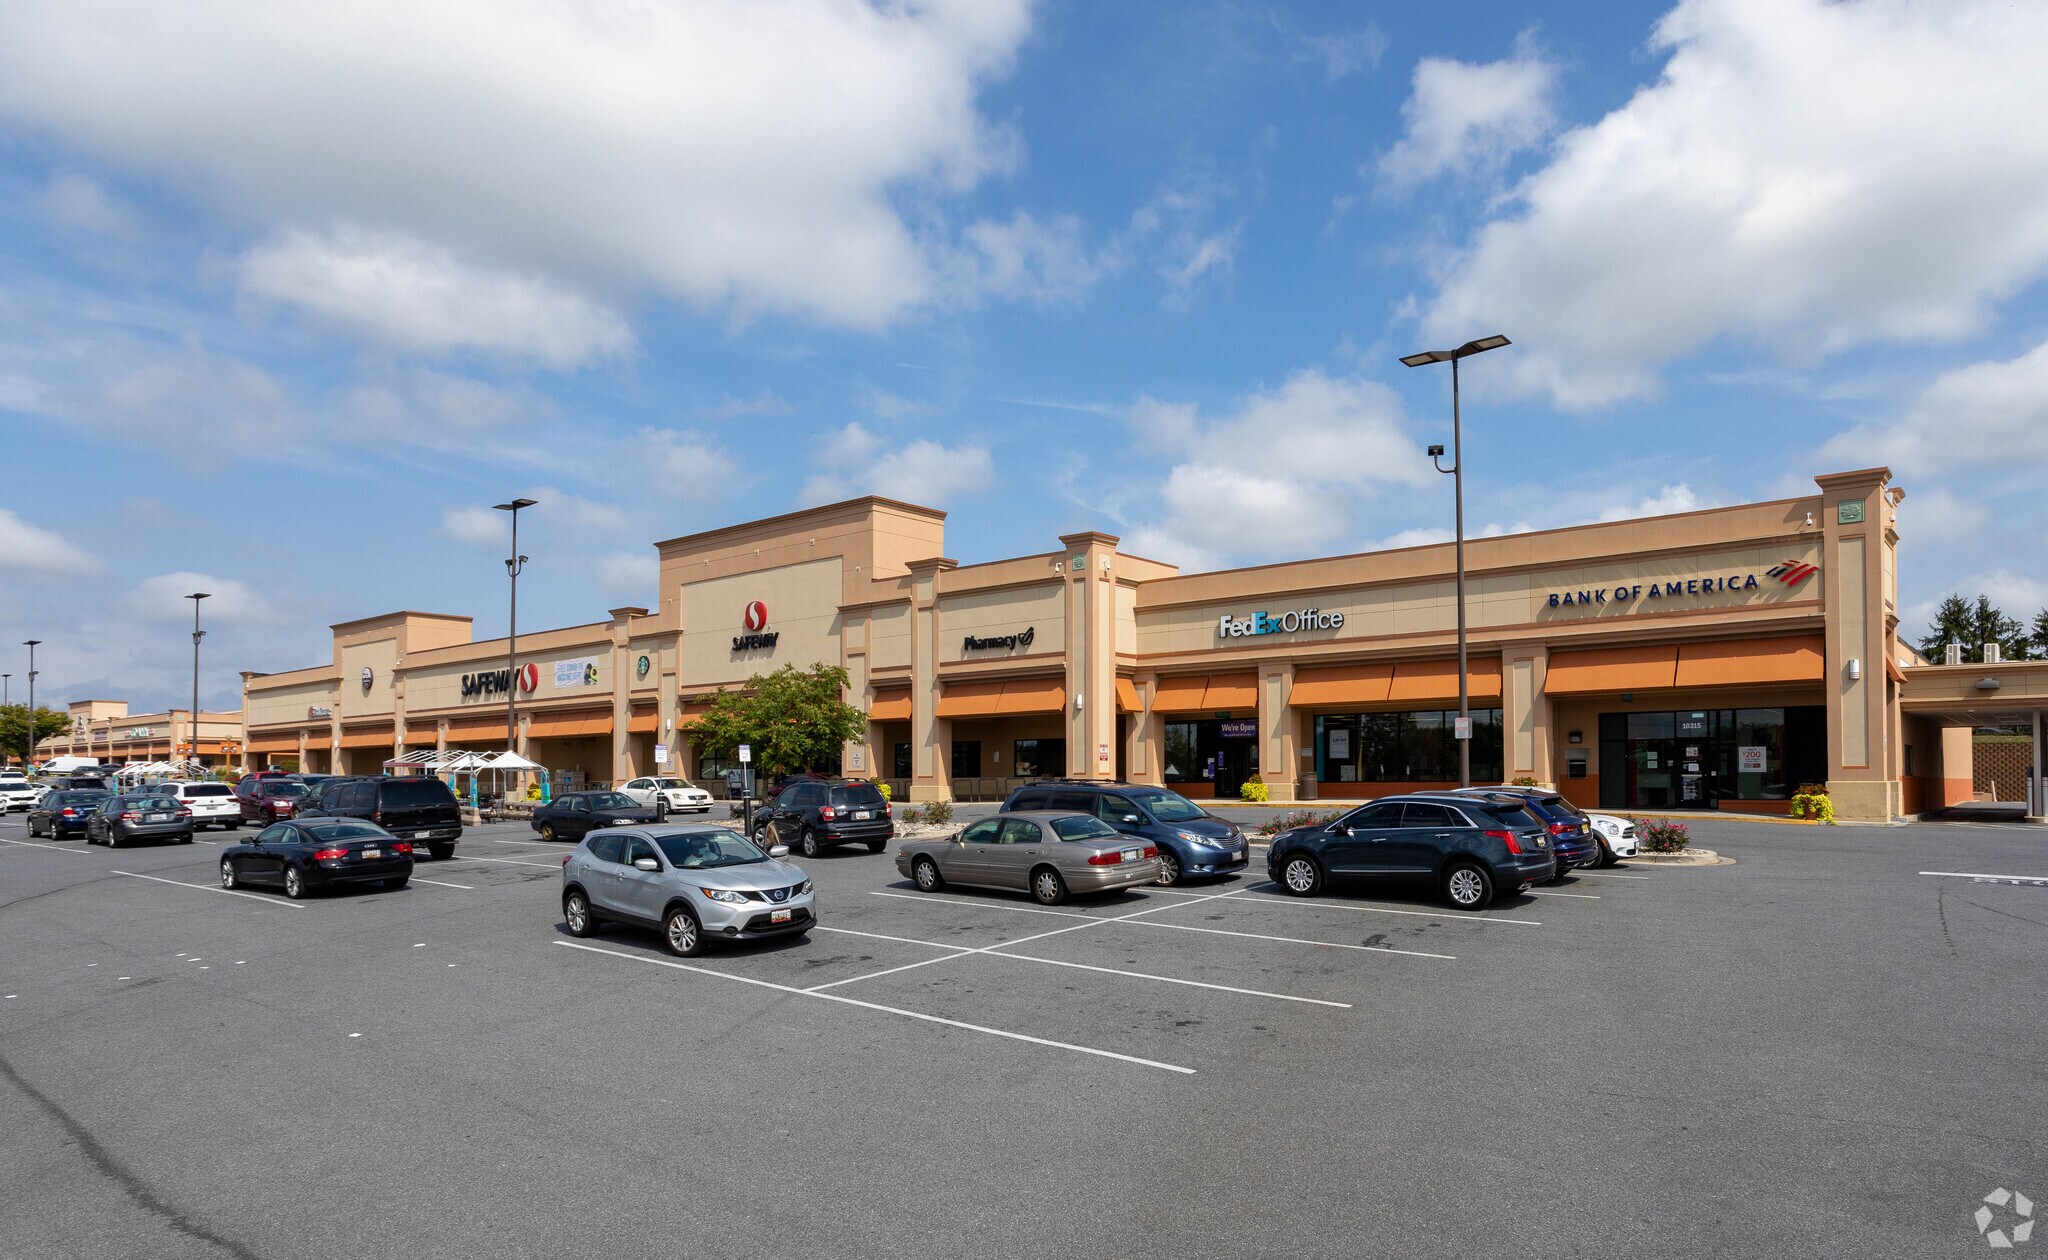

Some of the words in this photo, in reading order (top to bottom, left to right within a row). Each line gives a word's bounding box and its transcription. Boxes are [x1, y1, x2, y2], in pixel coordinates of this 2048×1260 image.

[1548, 588, 1607, 607] BANK
[1614, 585, 1642, 601] OF
[1648, 574, 1759, 598] AMERICA
[732, 632, 779, 652] SAFEWAY
[964, 635, 1017, 651] Pharmacy
[461, 668, 521, 696] SAFEWAY
[1221, 723, 1239, 732] We're
[1239, 723, 1256, 733] Open
[1682, 722, 1702, 730] 10315
